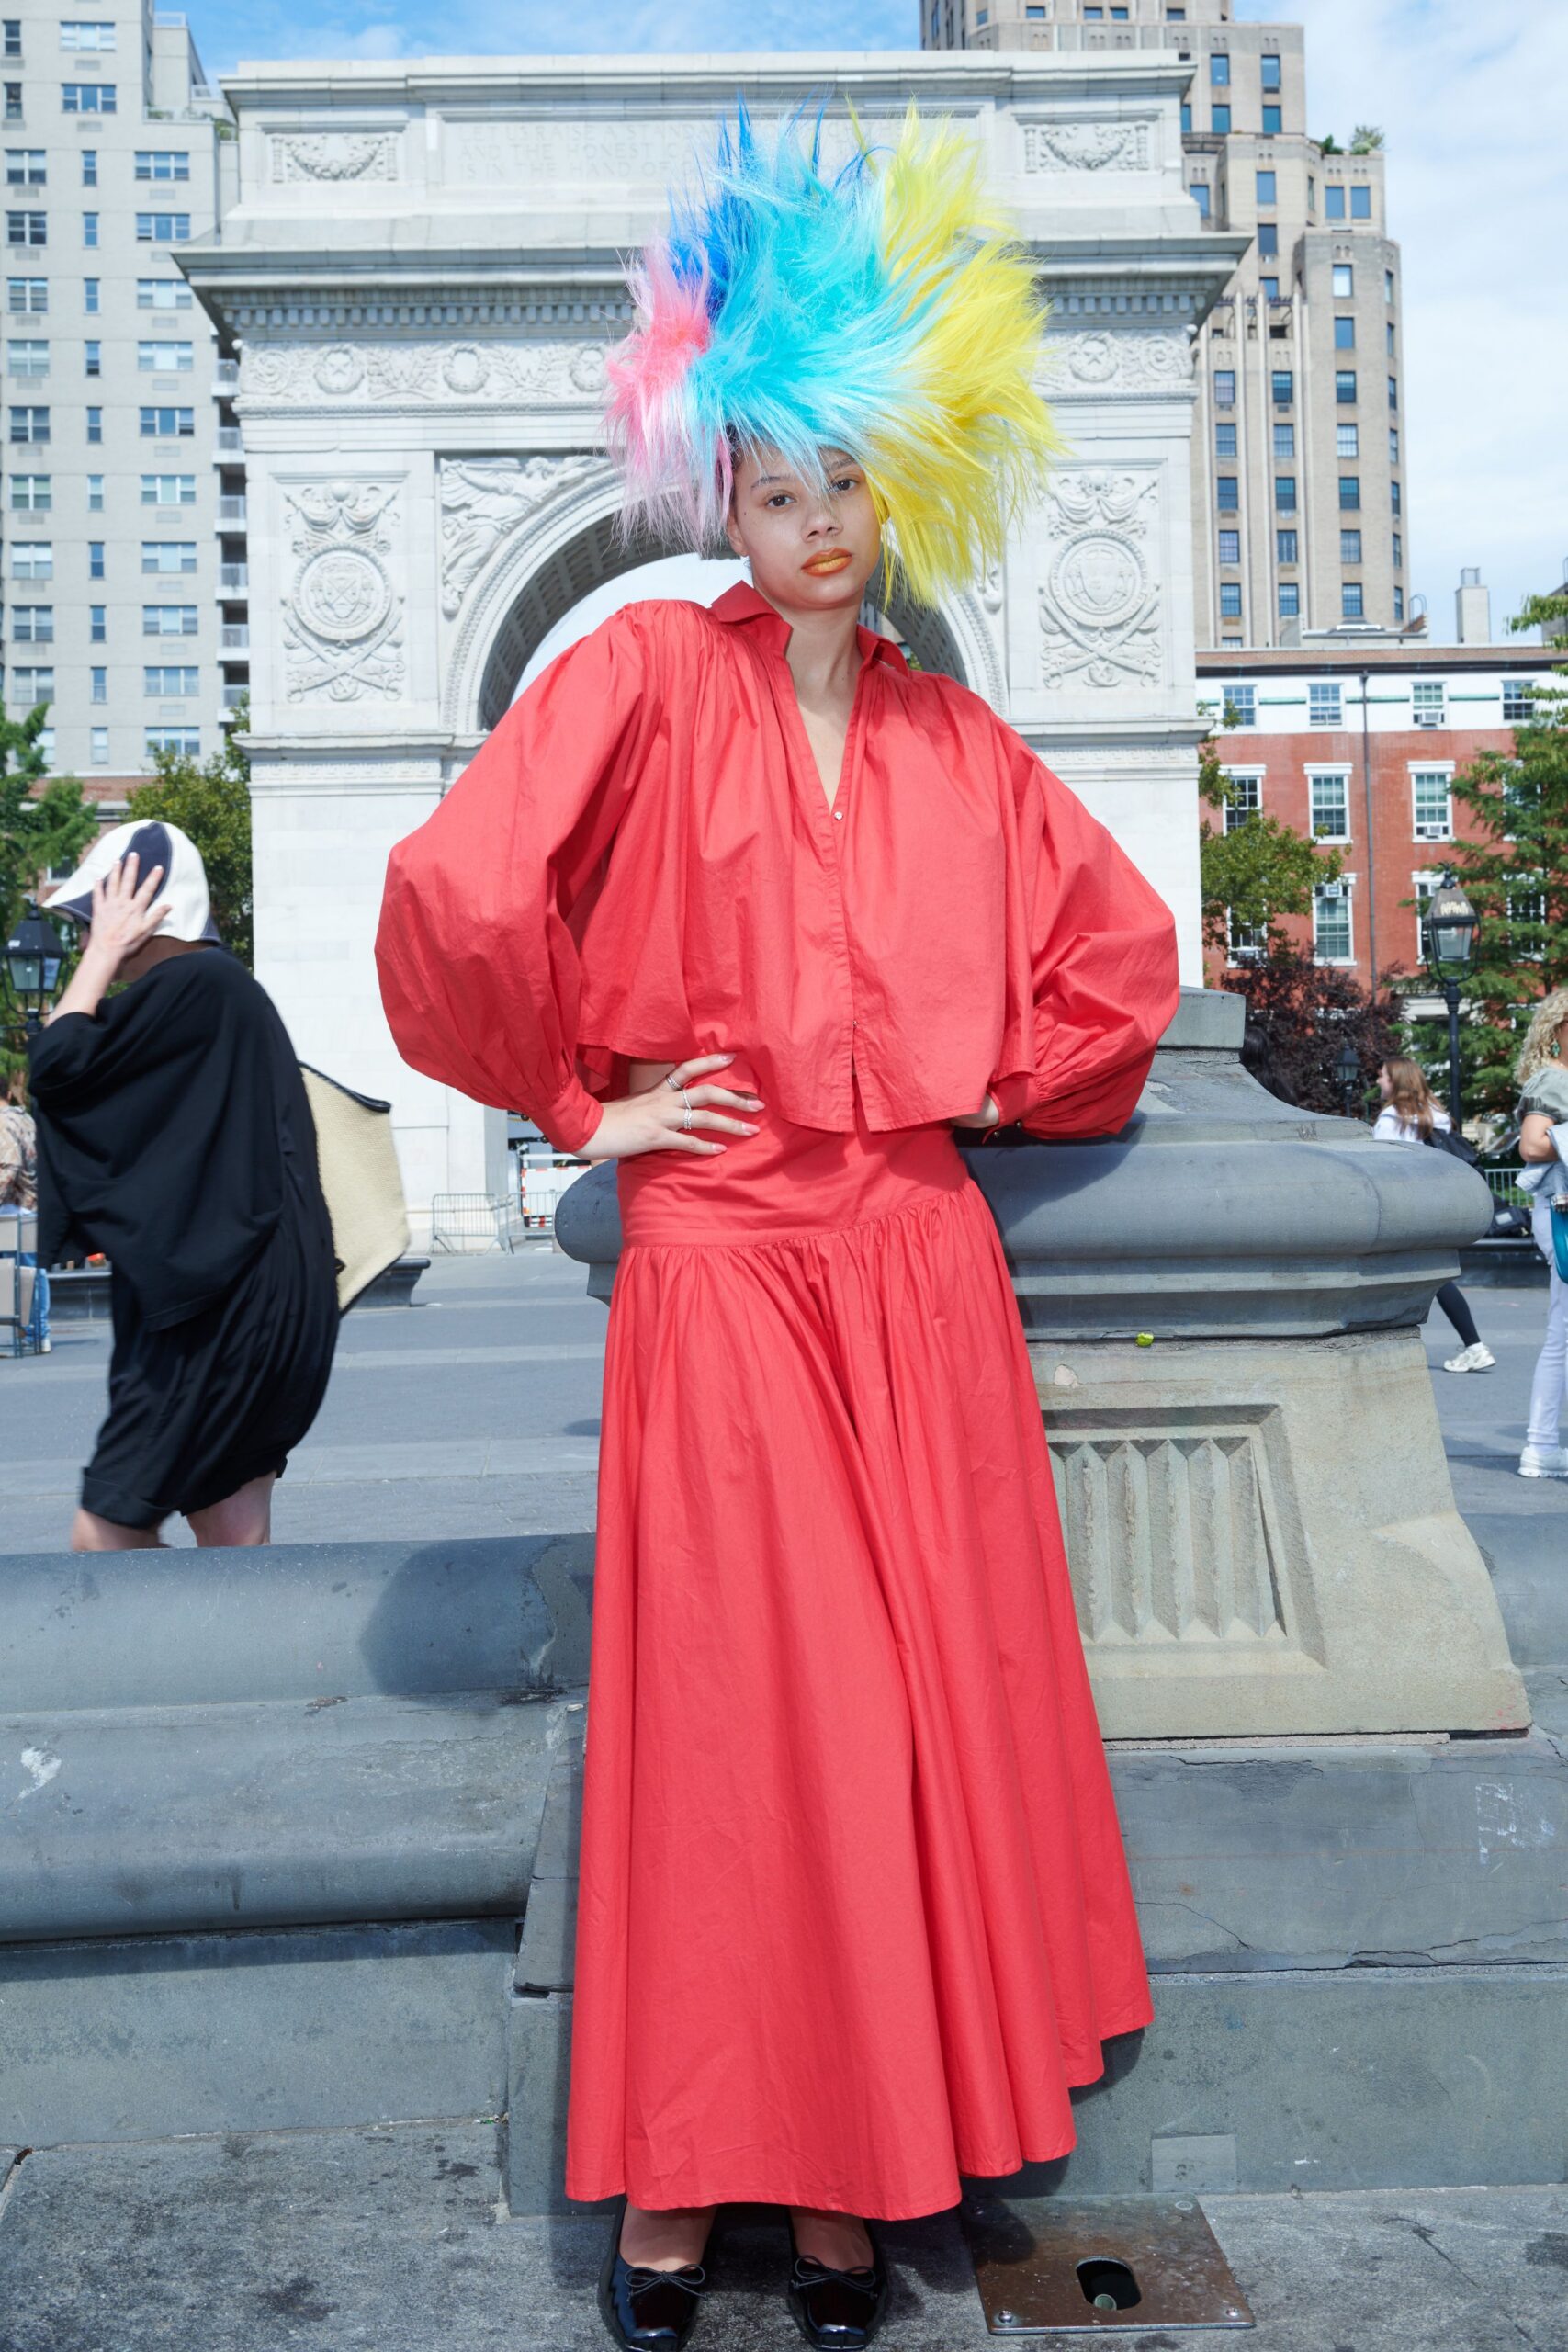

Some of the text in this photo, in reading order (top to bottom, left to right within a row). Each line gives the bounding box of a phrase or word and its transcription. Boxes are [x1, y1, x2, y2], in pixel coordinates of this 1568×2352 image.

[460, 125, 499, 142] LET
[505, 124, 529, 141] US
[536, 123, 595, 141] RAISE
[604, 123, 618, 141] A
[459, 143, 500, 160] AND
[510, 142, 552, 160] THE
[567, 142, 652, 159] HONEST
[461, 163, 477, 179] IS
[487, 163, 504, 178] IN
[515, 162, 558, 178] THE
[570, 161, 631, 178] HAND
